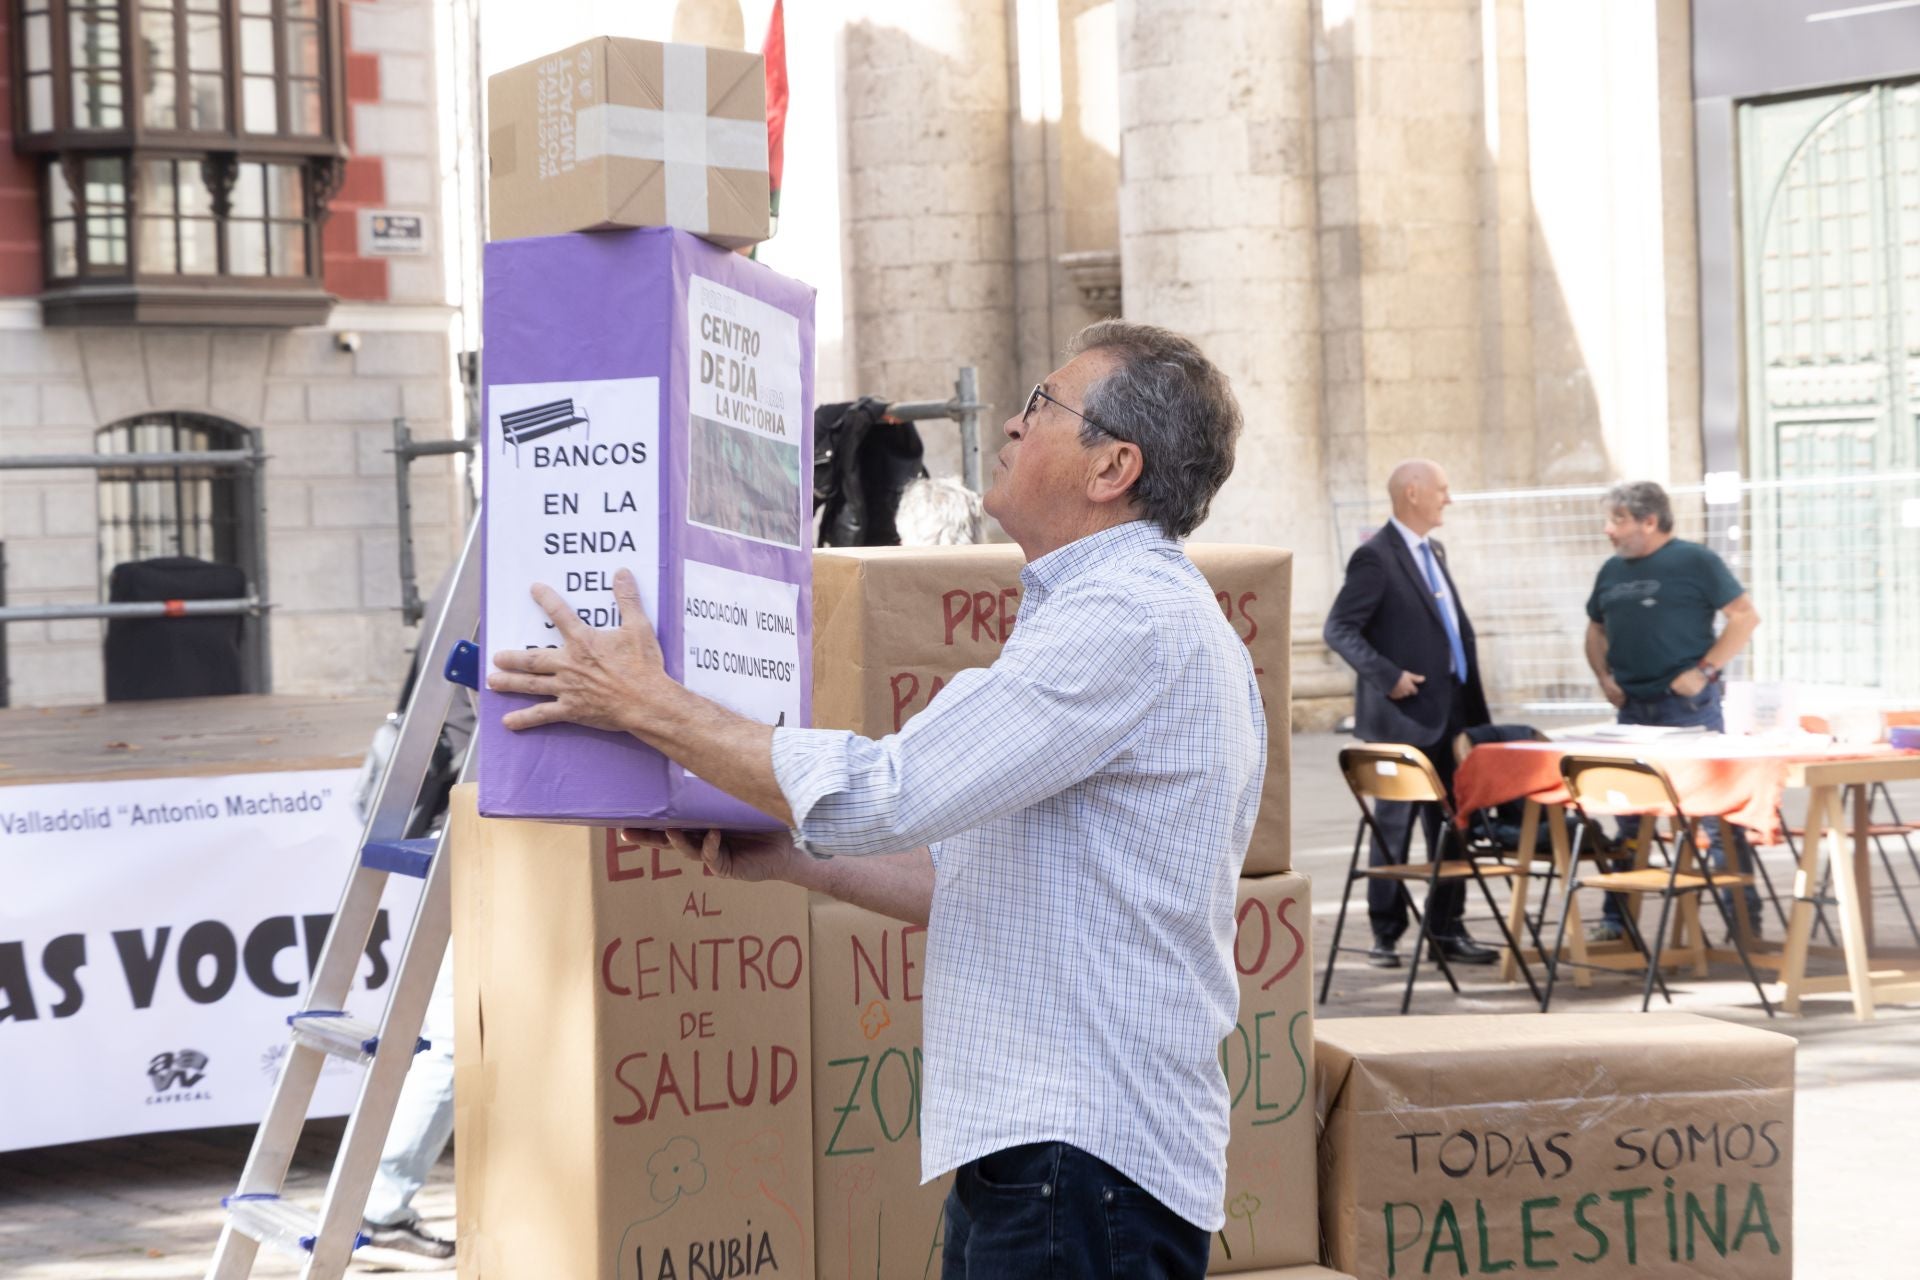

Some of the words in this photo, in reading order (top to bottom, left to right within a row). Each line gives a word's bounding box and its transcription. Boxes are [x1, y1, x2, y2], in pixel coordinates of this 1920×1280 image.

[547, 57, 560, 177] POSITIVE
[560, 56, 576, 172] IMPACT
[700, 312, 761, 358] CENTRO
[700, 349, 726, 390] DE
[728, 356, 758, 401] DÍA
[715, 393, 730, 419] LA
[731, 399, 786, 436] VICTORIA
[534, 442, 647, 468] BANCOS
[544, 493, 579, 515] EN
[604, 491, 637, 513] LA
[544, 531, 636, 555] SENDA
[566, 571, 614, 592] DEL
[685, 597, 748, 627] ASOCIACIÓN
[755, 611, 796, 636] VECINAL
[1, 808, 111, 835] Valladolid
[117, 799, 219, 827] “Antonio
[225, 789, 332, 817] Machado”
[682, 891, 722, 918] AL
[601, 935, 803, 1000] CENTRO
[679, 1011, 716, 1040] DE
[613, 1045, 798, 1125] SALUD
[1395, 1129, 1574, 1180] TODAS
[1614, 1119, 1784, 1173] SOMOS
[688, 1219, 779, 1280] RUBIA
[1383, 1175, 1783, 1279] PALESTINA
